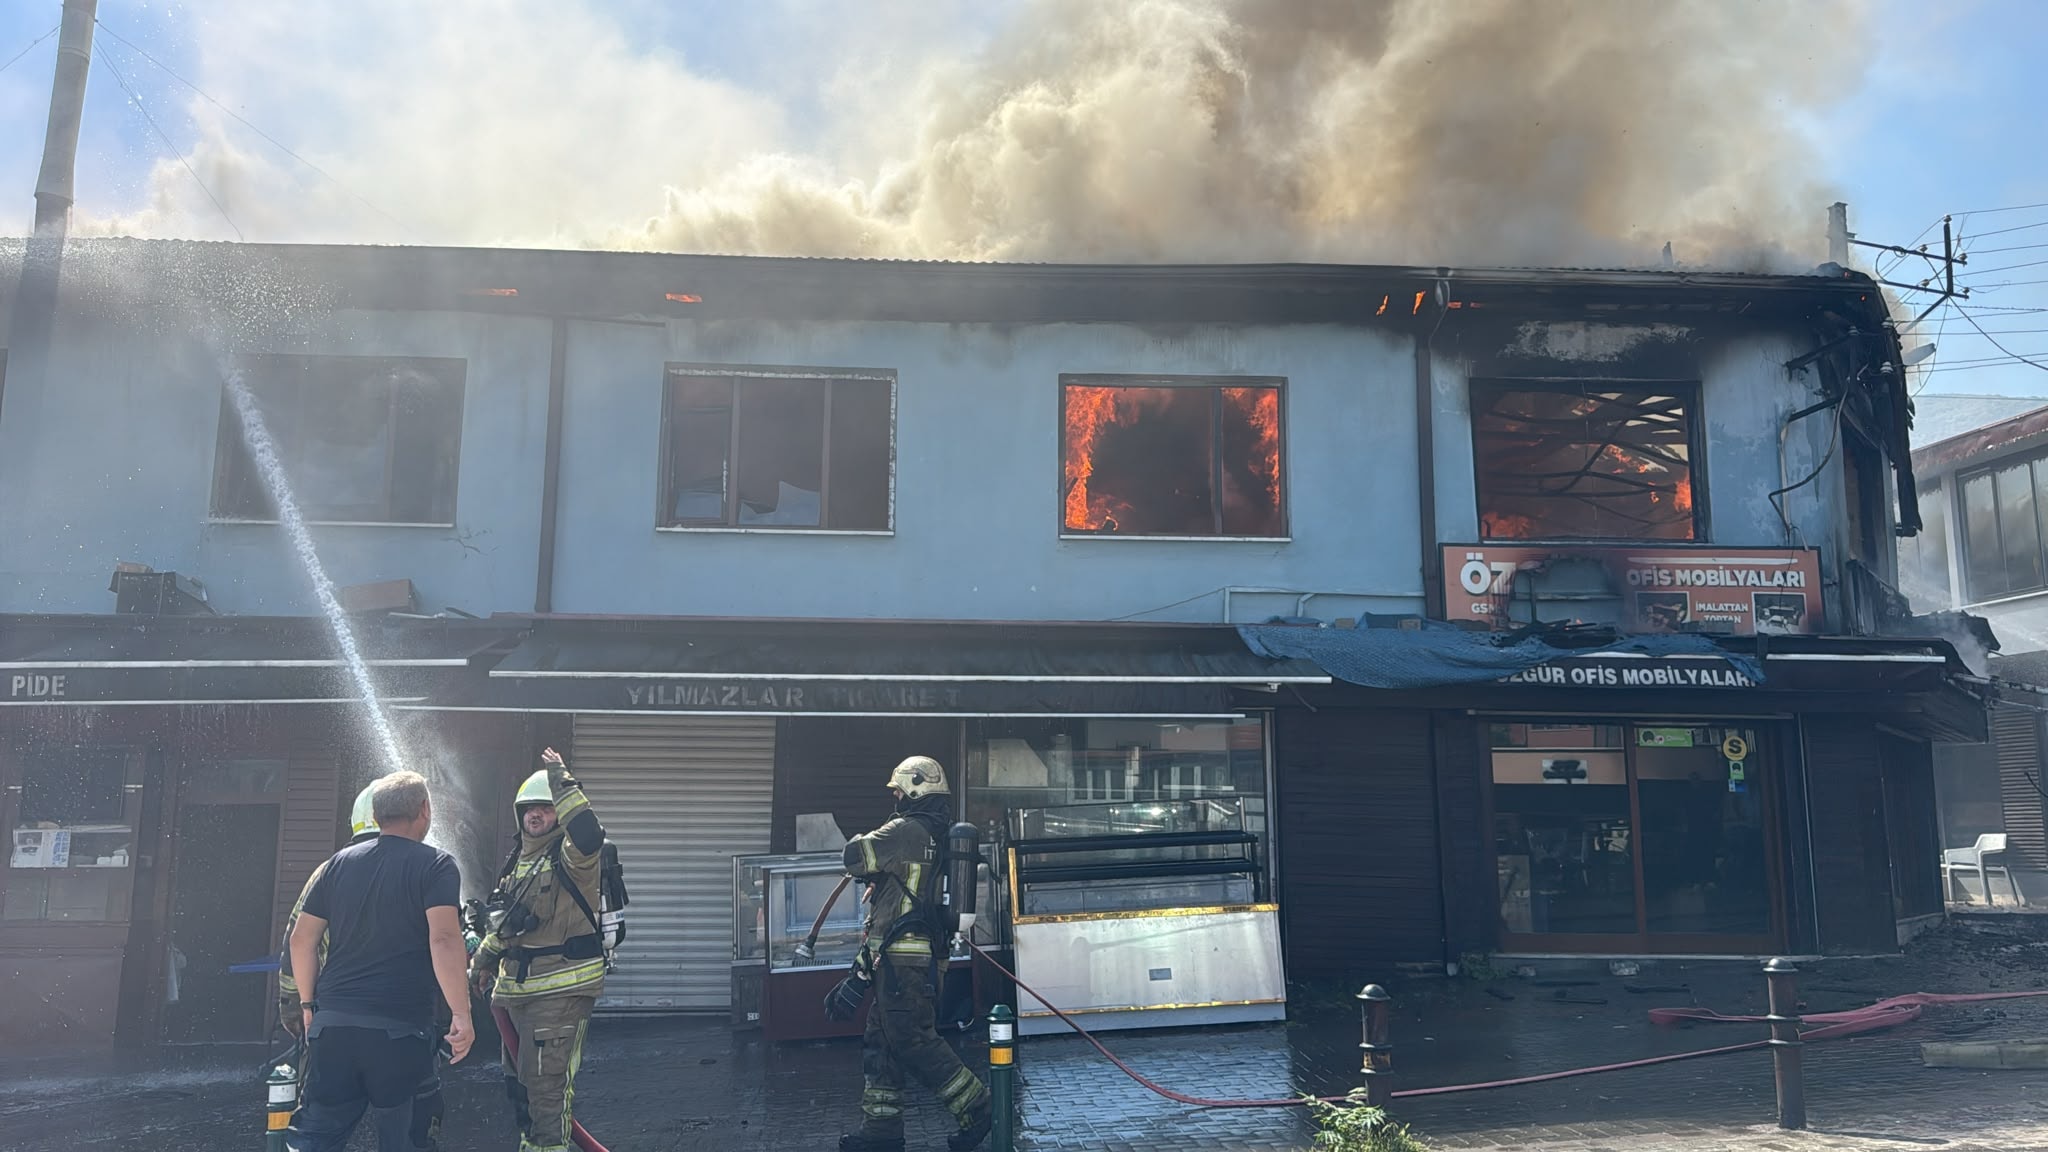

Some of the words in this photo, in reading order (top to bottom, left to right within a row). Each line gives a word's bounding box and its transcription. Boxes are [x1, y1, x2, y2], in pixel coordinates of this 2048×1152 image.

[1626, 565, 1672, 586] OFİS
[1675, 565, 1806, 588] MOBİLYALARI
[11, 672, 66, 697] PİDE
[1570, 664, 1618, 685] OFİS
[1621, 665, 1756, 687] MOBİLYALAR
[626, 685, 804, 707] YILMAZLAR
